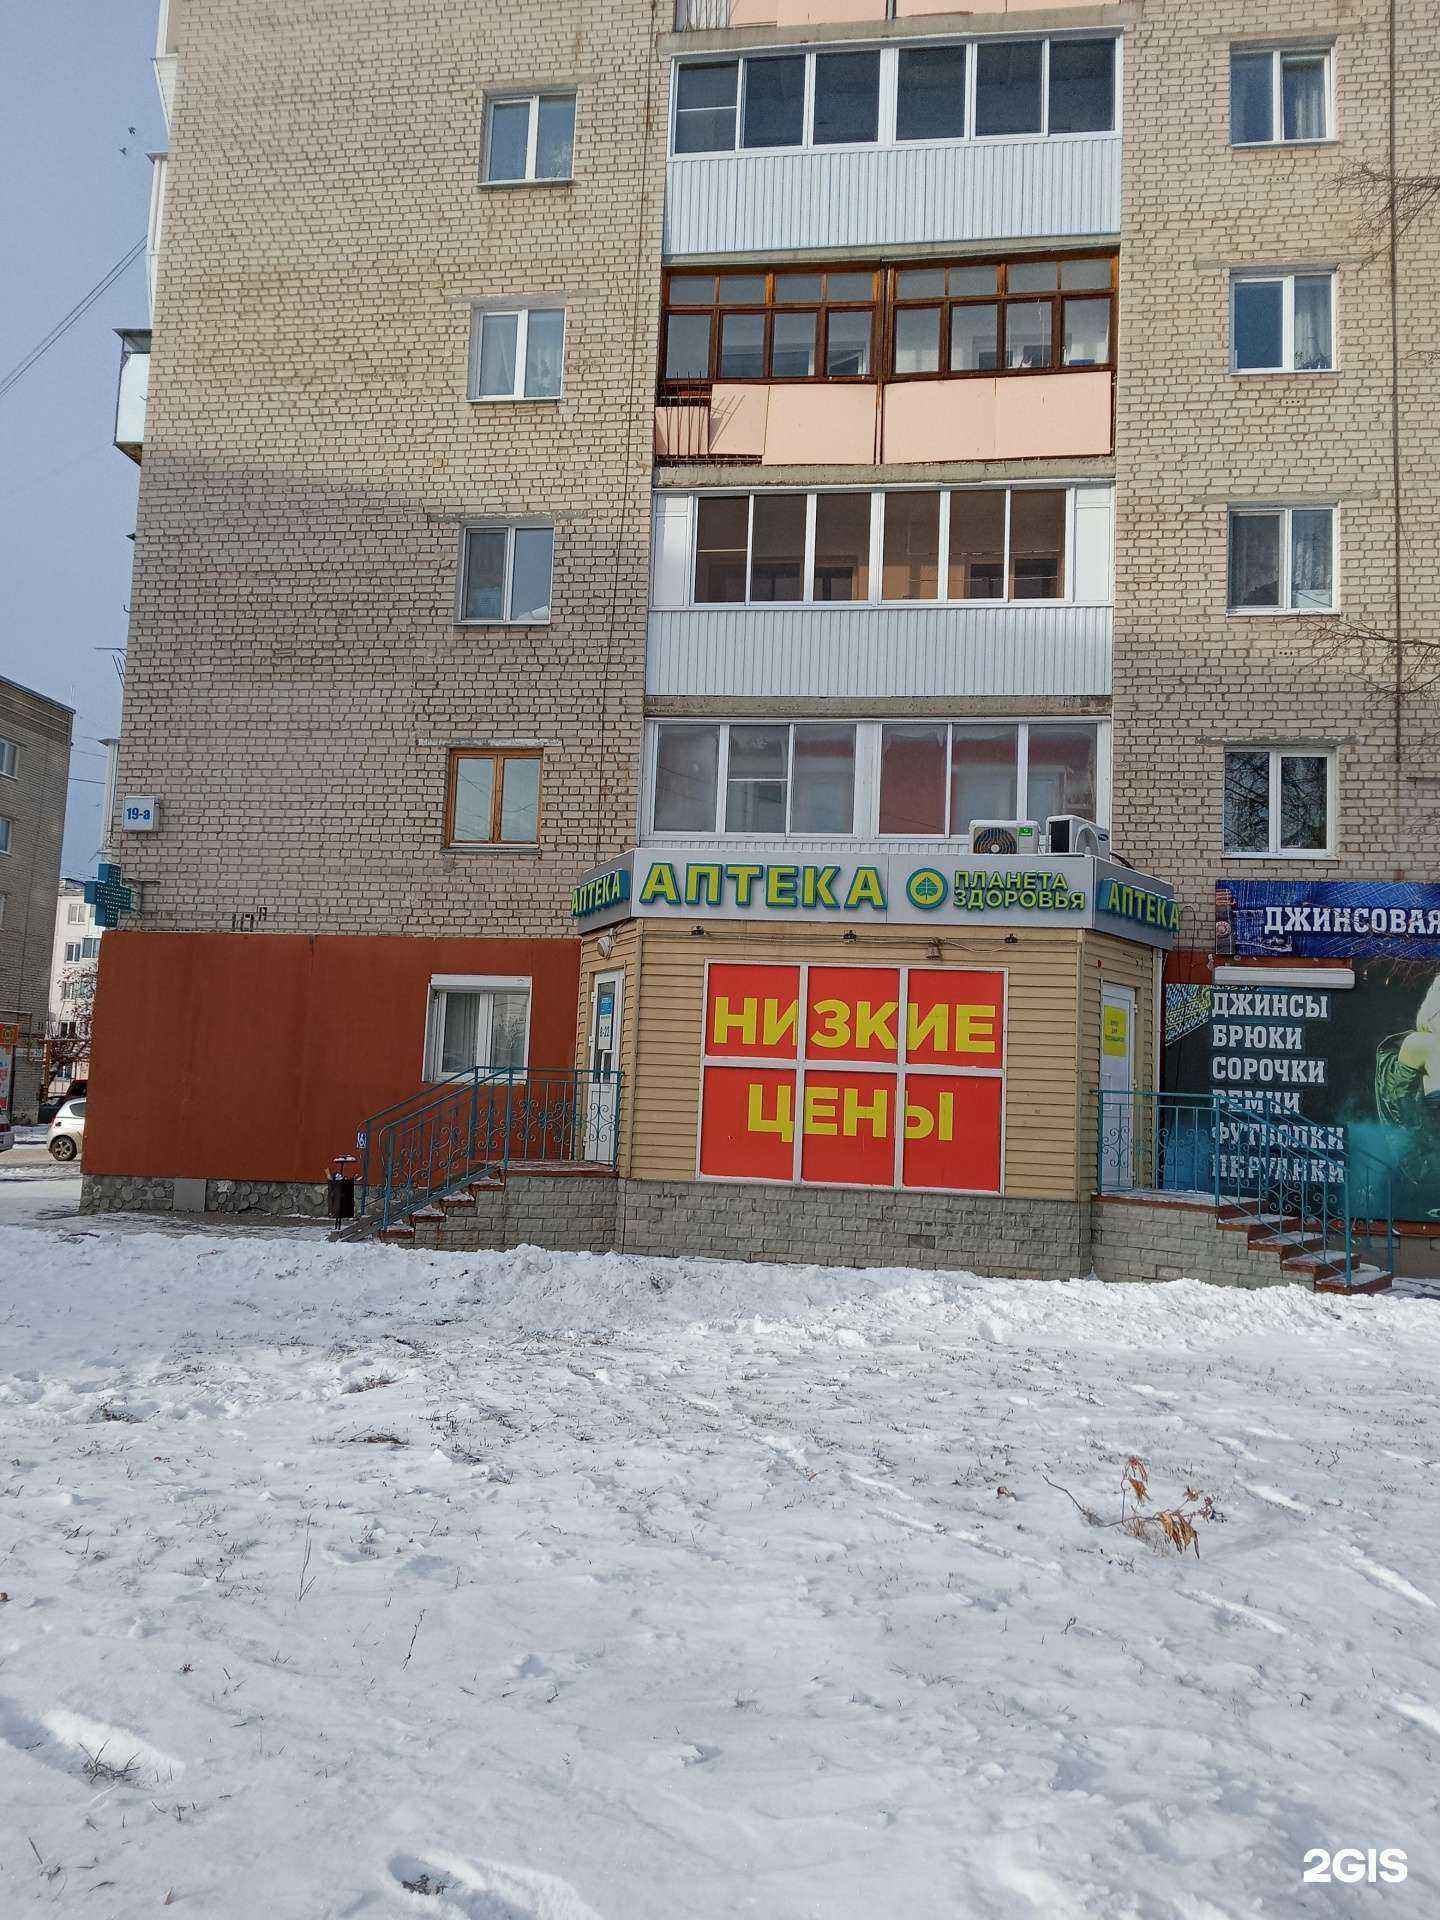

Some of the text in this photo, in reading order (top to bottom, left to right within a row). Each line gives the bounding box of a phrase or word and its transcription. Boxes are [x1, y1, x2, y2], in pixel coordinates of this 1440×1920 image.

[126, 807, 151, 820] 19-а
[571, 868, 623, 917] АПТЕКА
[639, 862, 888, 911] АПТЕКА
[953, 870, 1068, 890] ПЛАНЕТА
[952, 888, 1086, 911] ЗДОРОВЬЯ
[1107, 880, 1180, 932] АПТЕКА
[1264, 906, 1440, 935] ДЖИНСОВАЯ
[1211, 992, 1328, 1019] ДЖИНСЫ
[713, 996, 996, 1054] НИЗКИЕ
[1212, 1024, 1302, 1050] БРЮКИ
[1212, 1056, 1325, 1083] СОРОЧКИ
[747, 1083, 954, 1143] ЦЕНЫ
